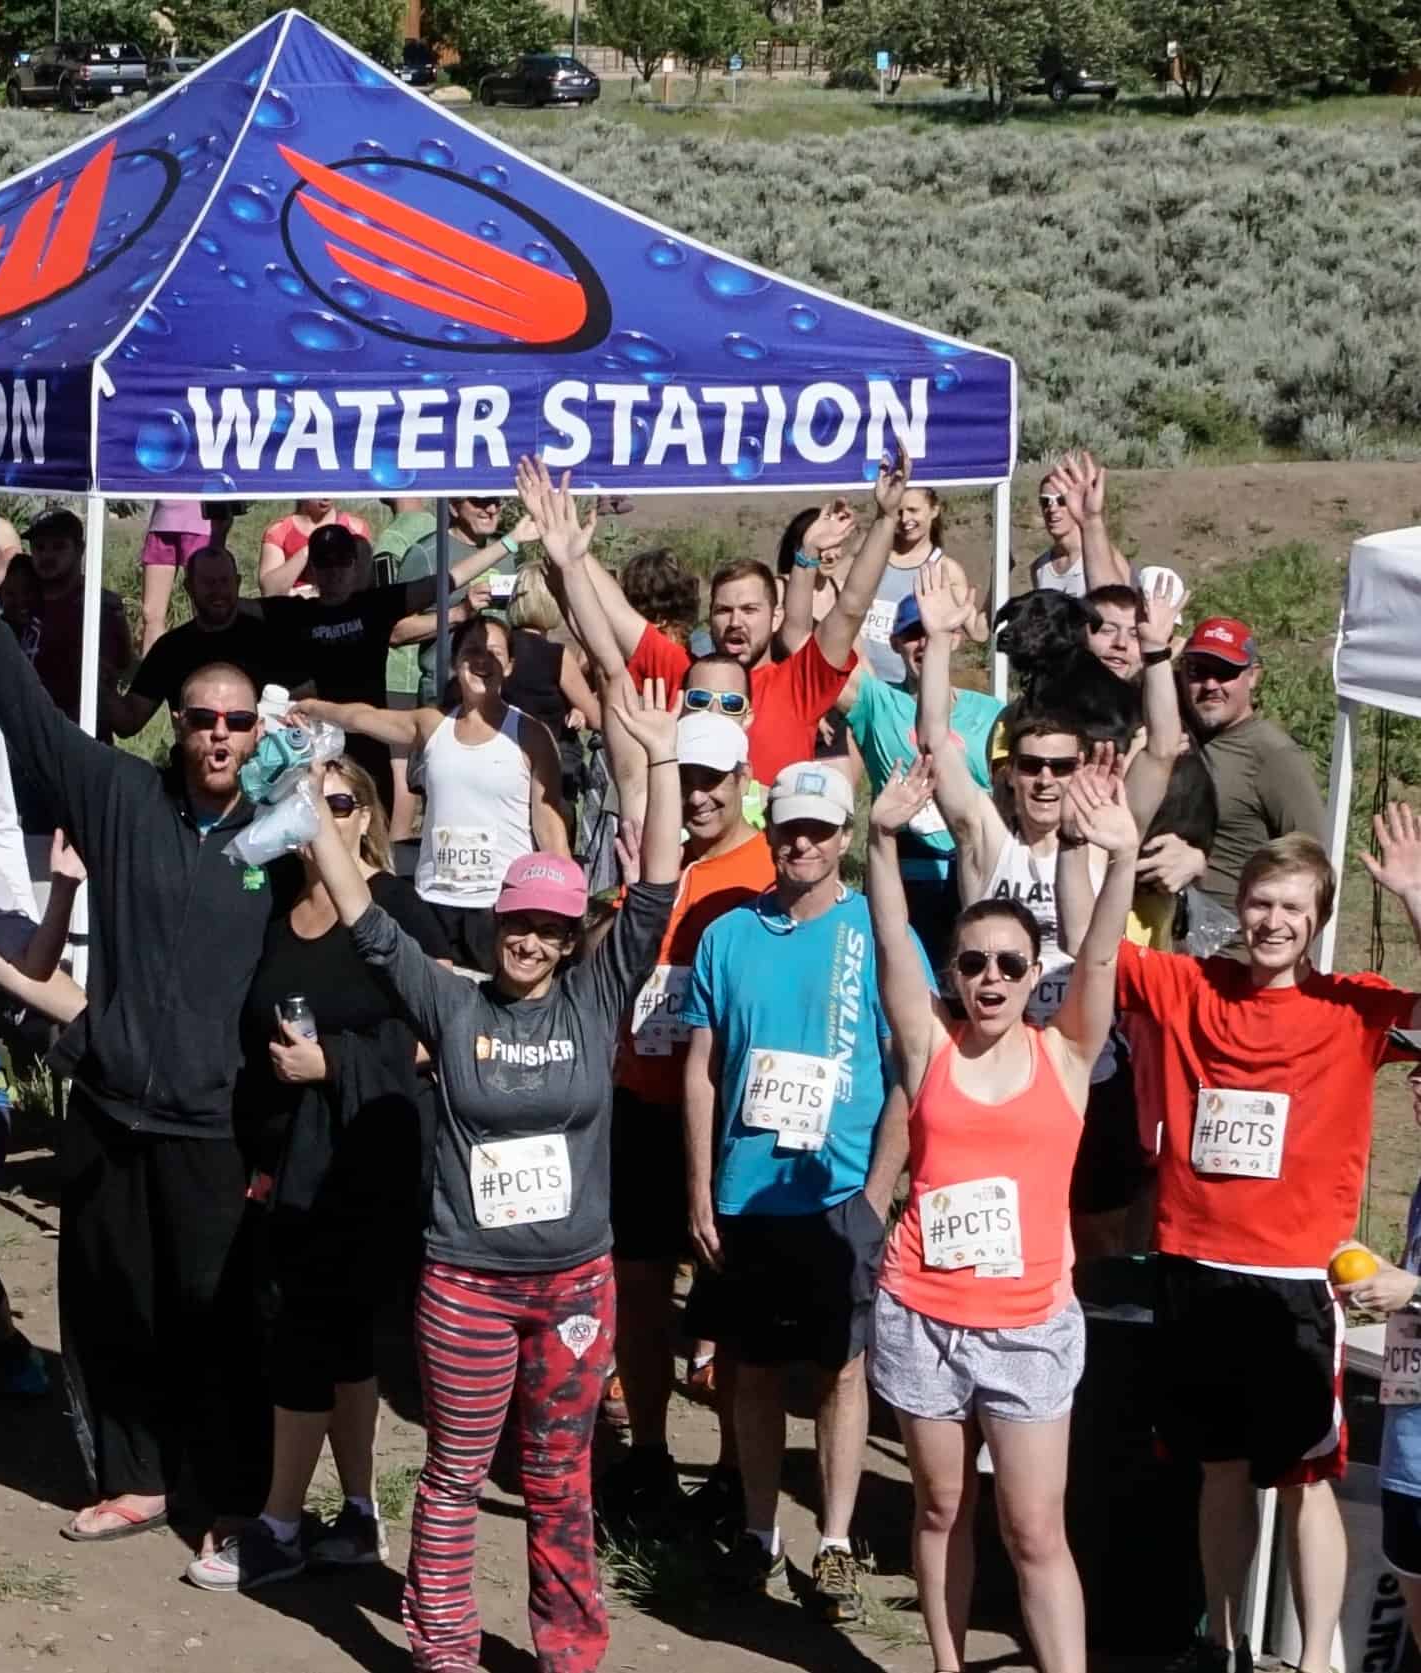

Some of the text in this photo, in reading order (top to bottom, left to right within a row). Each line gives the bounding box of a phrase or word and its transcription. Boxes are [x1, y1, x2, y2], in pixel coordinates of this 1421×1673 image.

[188, 378, 929, 470] WATER STATION
[437, 848, 491, 866] #PCTS
[835, 928, 864, 1100] SKYLINE
[491, 1038, 575, 1067] FINISHER
[749, 1077, 823, 1109] #PCTS
[1199, 1119, 1274, 1147] #PCTS
[480, 1165, 562, 1200] #PCTS
[929, 1207, 1011, 1243] #PCTS
